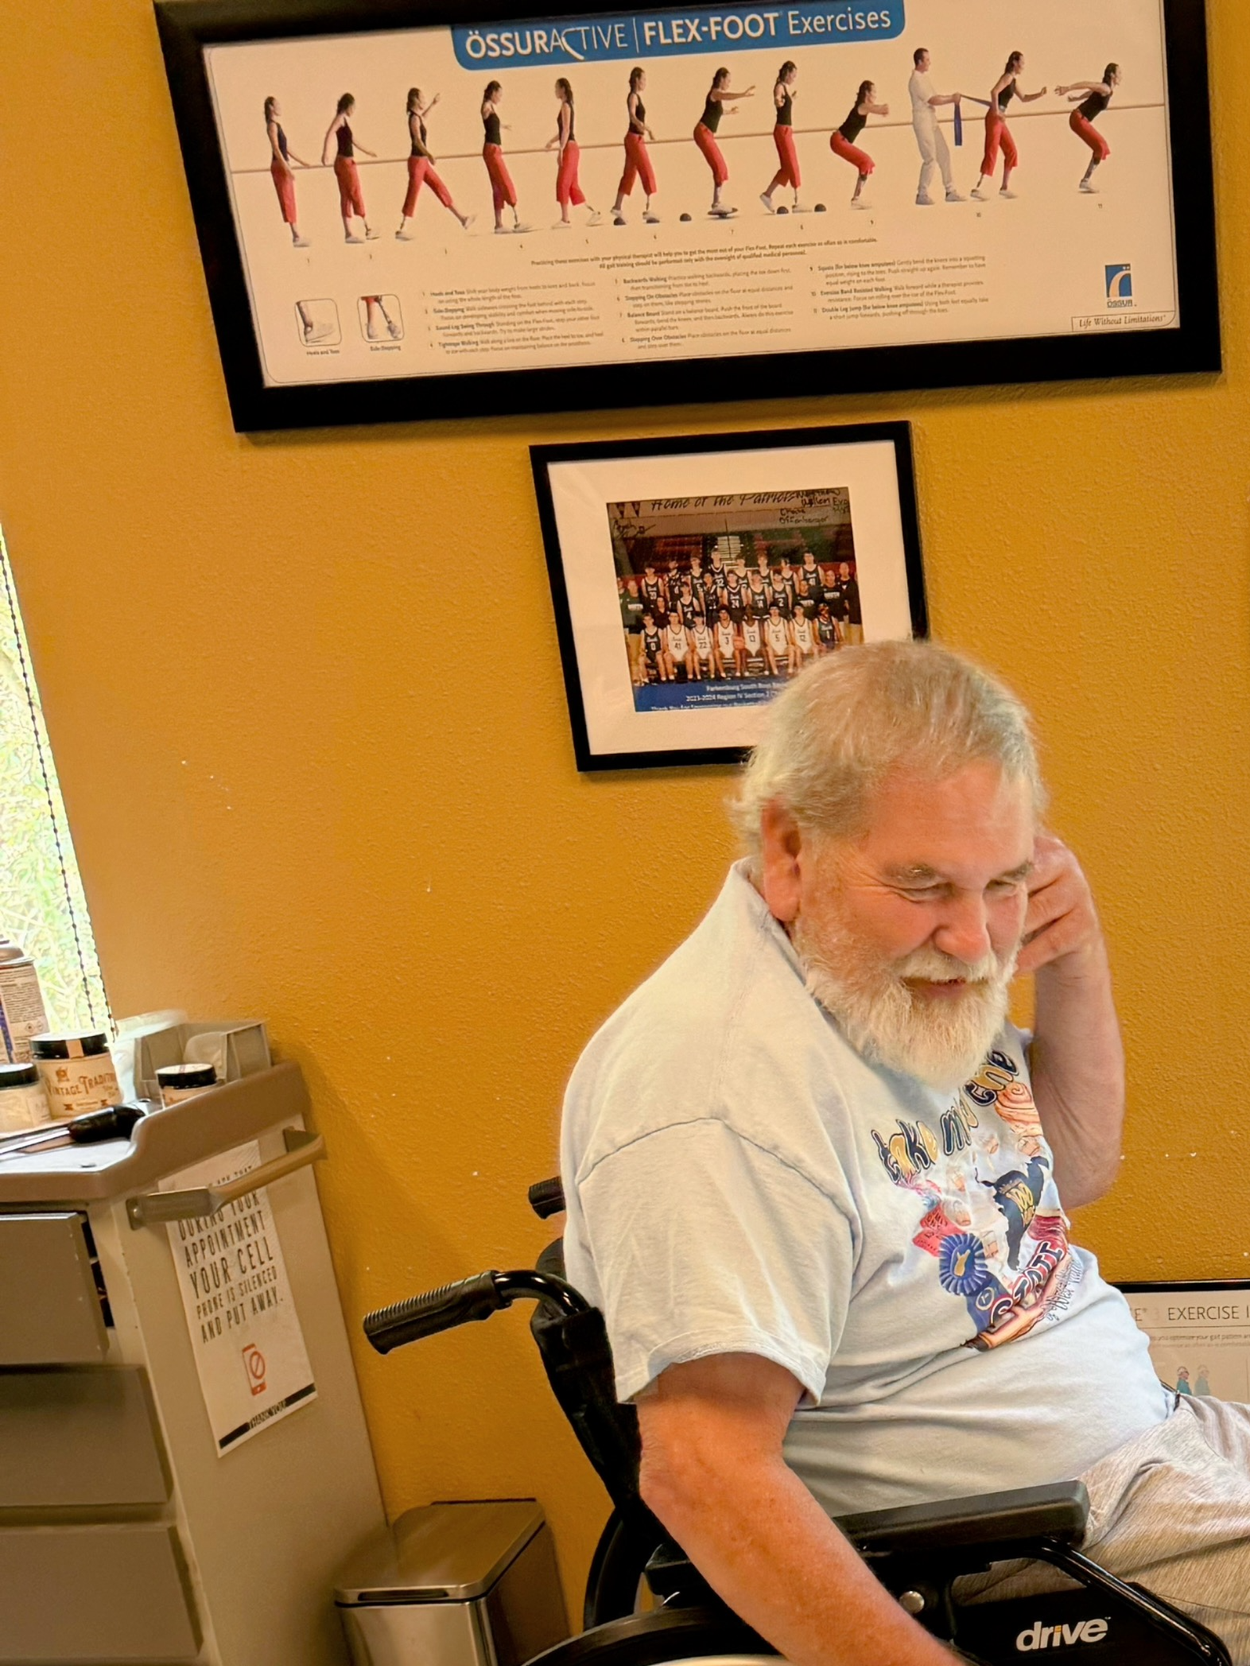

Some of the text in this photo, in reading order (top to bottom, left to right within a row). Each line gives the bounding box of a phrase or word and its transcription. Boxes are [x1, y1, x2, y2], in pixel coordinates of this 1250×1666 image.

[644, 13, 780, 46] FLEX-FOOT
[787, 8, 891, 35] Exercises
[1079, 316, 1163, 329] Life Without Limitations
[185, 1210, 265, 1268] APPOINTMENT
[190, 1236, 273, 1299] YOUR CELL
[196, 1266, 277, 1320] PHONE IS SILENCED
[201, 1286, 283, 1344] AND PUT AWAY.
[1168, 1306, 1240, 1320] EXERCISE
[1016, 1618, 1108, 1652] drive
